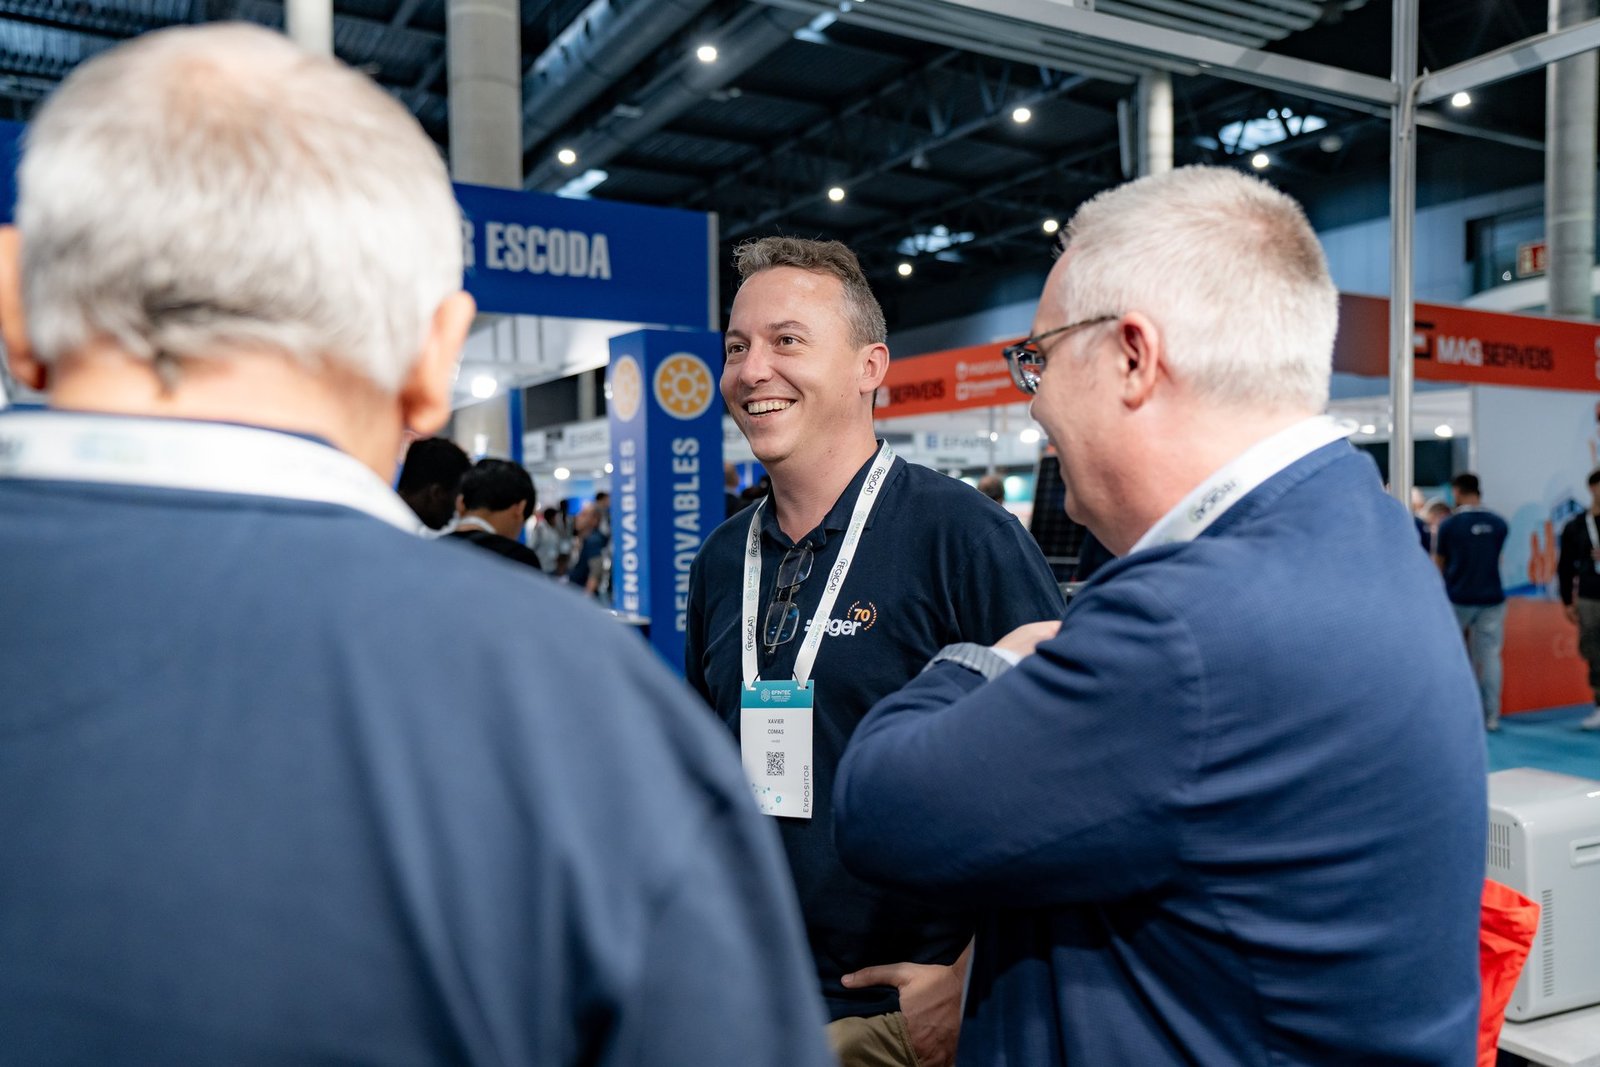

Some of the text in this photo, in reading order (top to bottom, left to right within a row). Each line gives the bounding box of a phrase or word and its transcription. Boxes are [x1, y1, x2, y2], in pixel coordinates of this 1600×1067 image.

[485, 221, 612, 280] ESCODA
[830, 561, 846, 592] FEGICAT
[853, 608, 871, 622] 70
